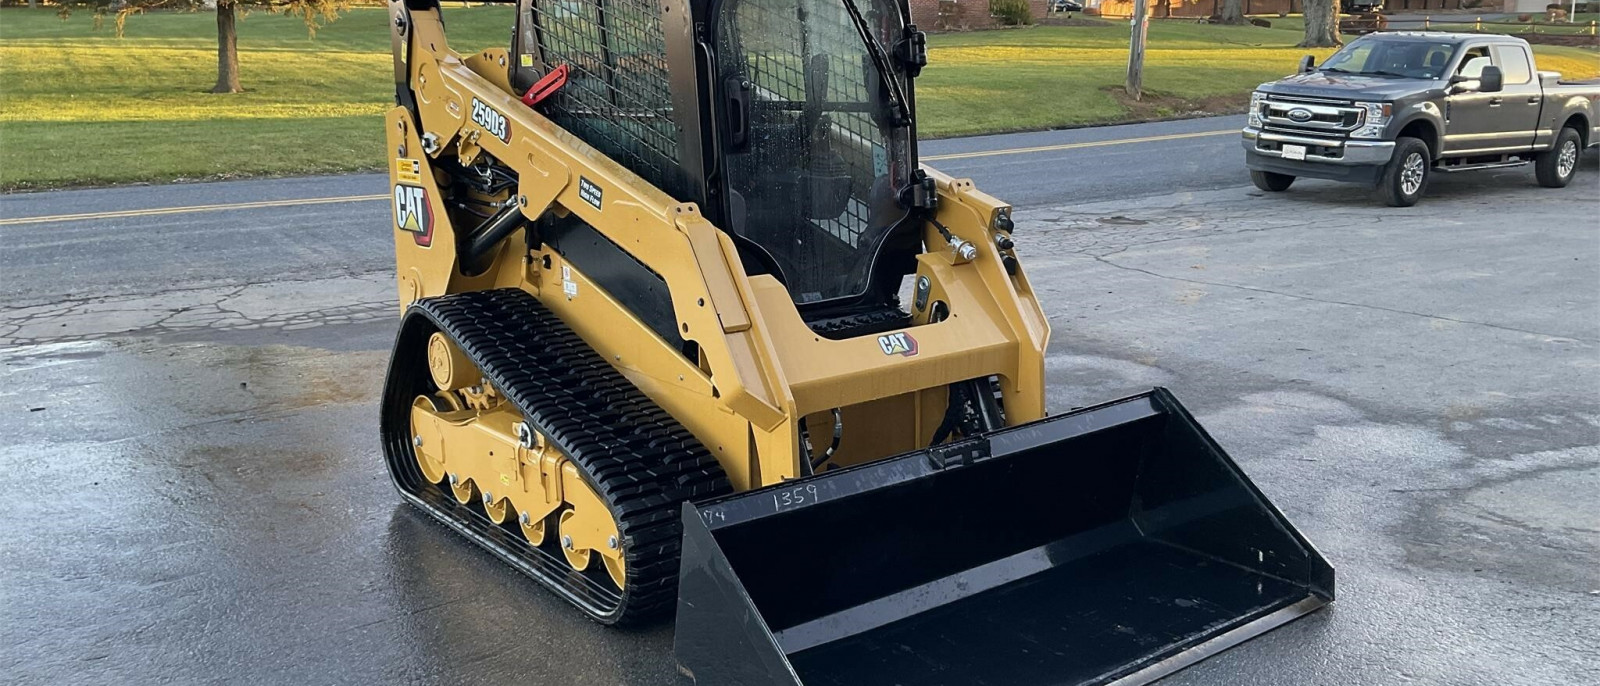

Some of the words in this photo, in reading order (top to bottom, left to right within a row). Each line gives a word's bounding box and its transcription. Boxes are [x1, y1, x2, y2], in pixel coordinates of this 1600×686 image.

[472, 97, 506, 140] 259D3
[395, 184, 424, 232] CAT
[878, 332, 910, 355] CAT
[773, 484, 818, 511] 1359
[703, 509, 725, 524] 74
